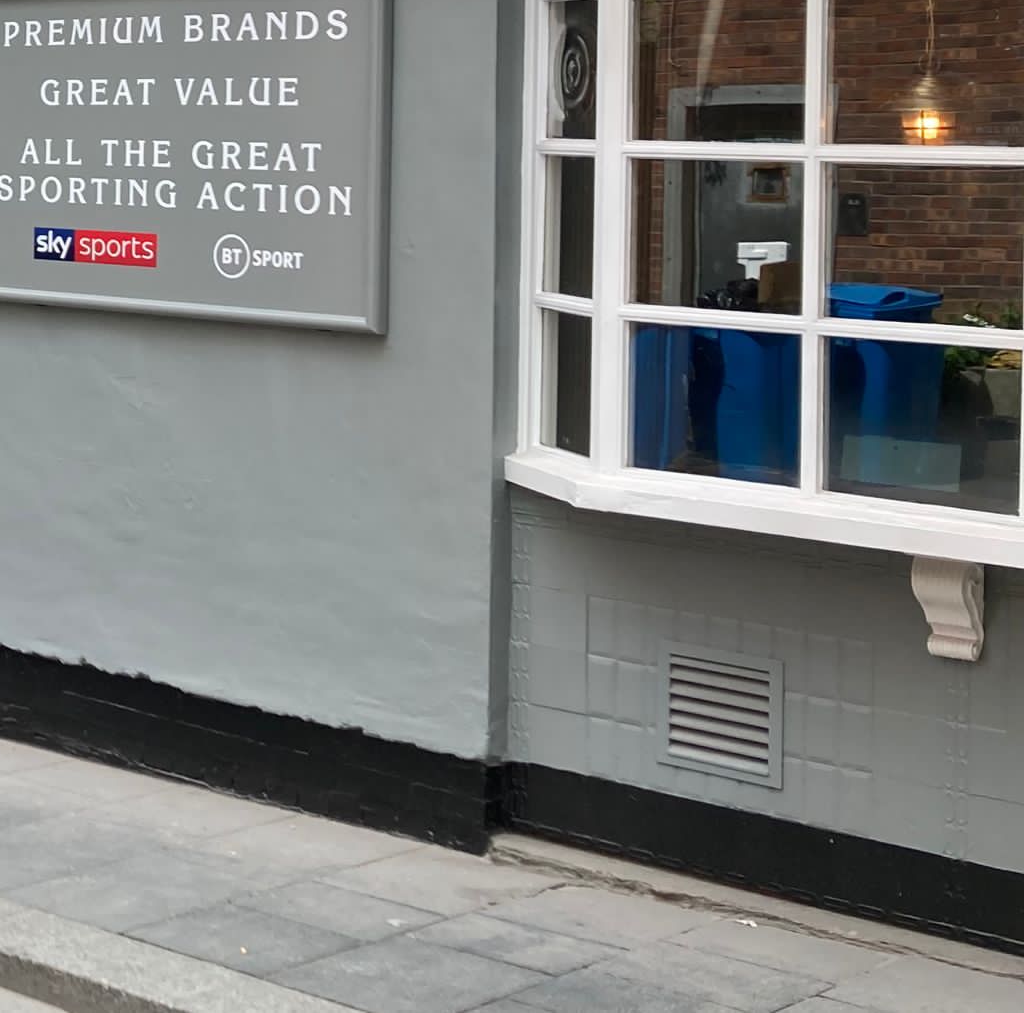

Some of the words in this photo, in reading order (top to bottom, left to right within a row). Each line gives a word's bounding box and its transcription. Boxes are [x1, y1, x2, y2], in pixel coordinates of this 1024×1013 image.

[3, 15, 164, 47] PREMIUM
[183, 9, 349, 43] BRANDS
[40, 78, 156, 106] GREAT
[174, 77, 299, 107] VALUE
[20, 138, 82, 166] ALL
[100, 139, 171, 168] THE
[191, 140, 322, 172] GREAT
[196, 181, 352, 216] ACTION
[36, 230, 72, 259] sky
[79, 237, 154, 260] sports
[221, 247, 242, 265] BT
[252, 250, 304, 269] SPORT
